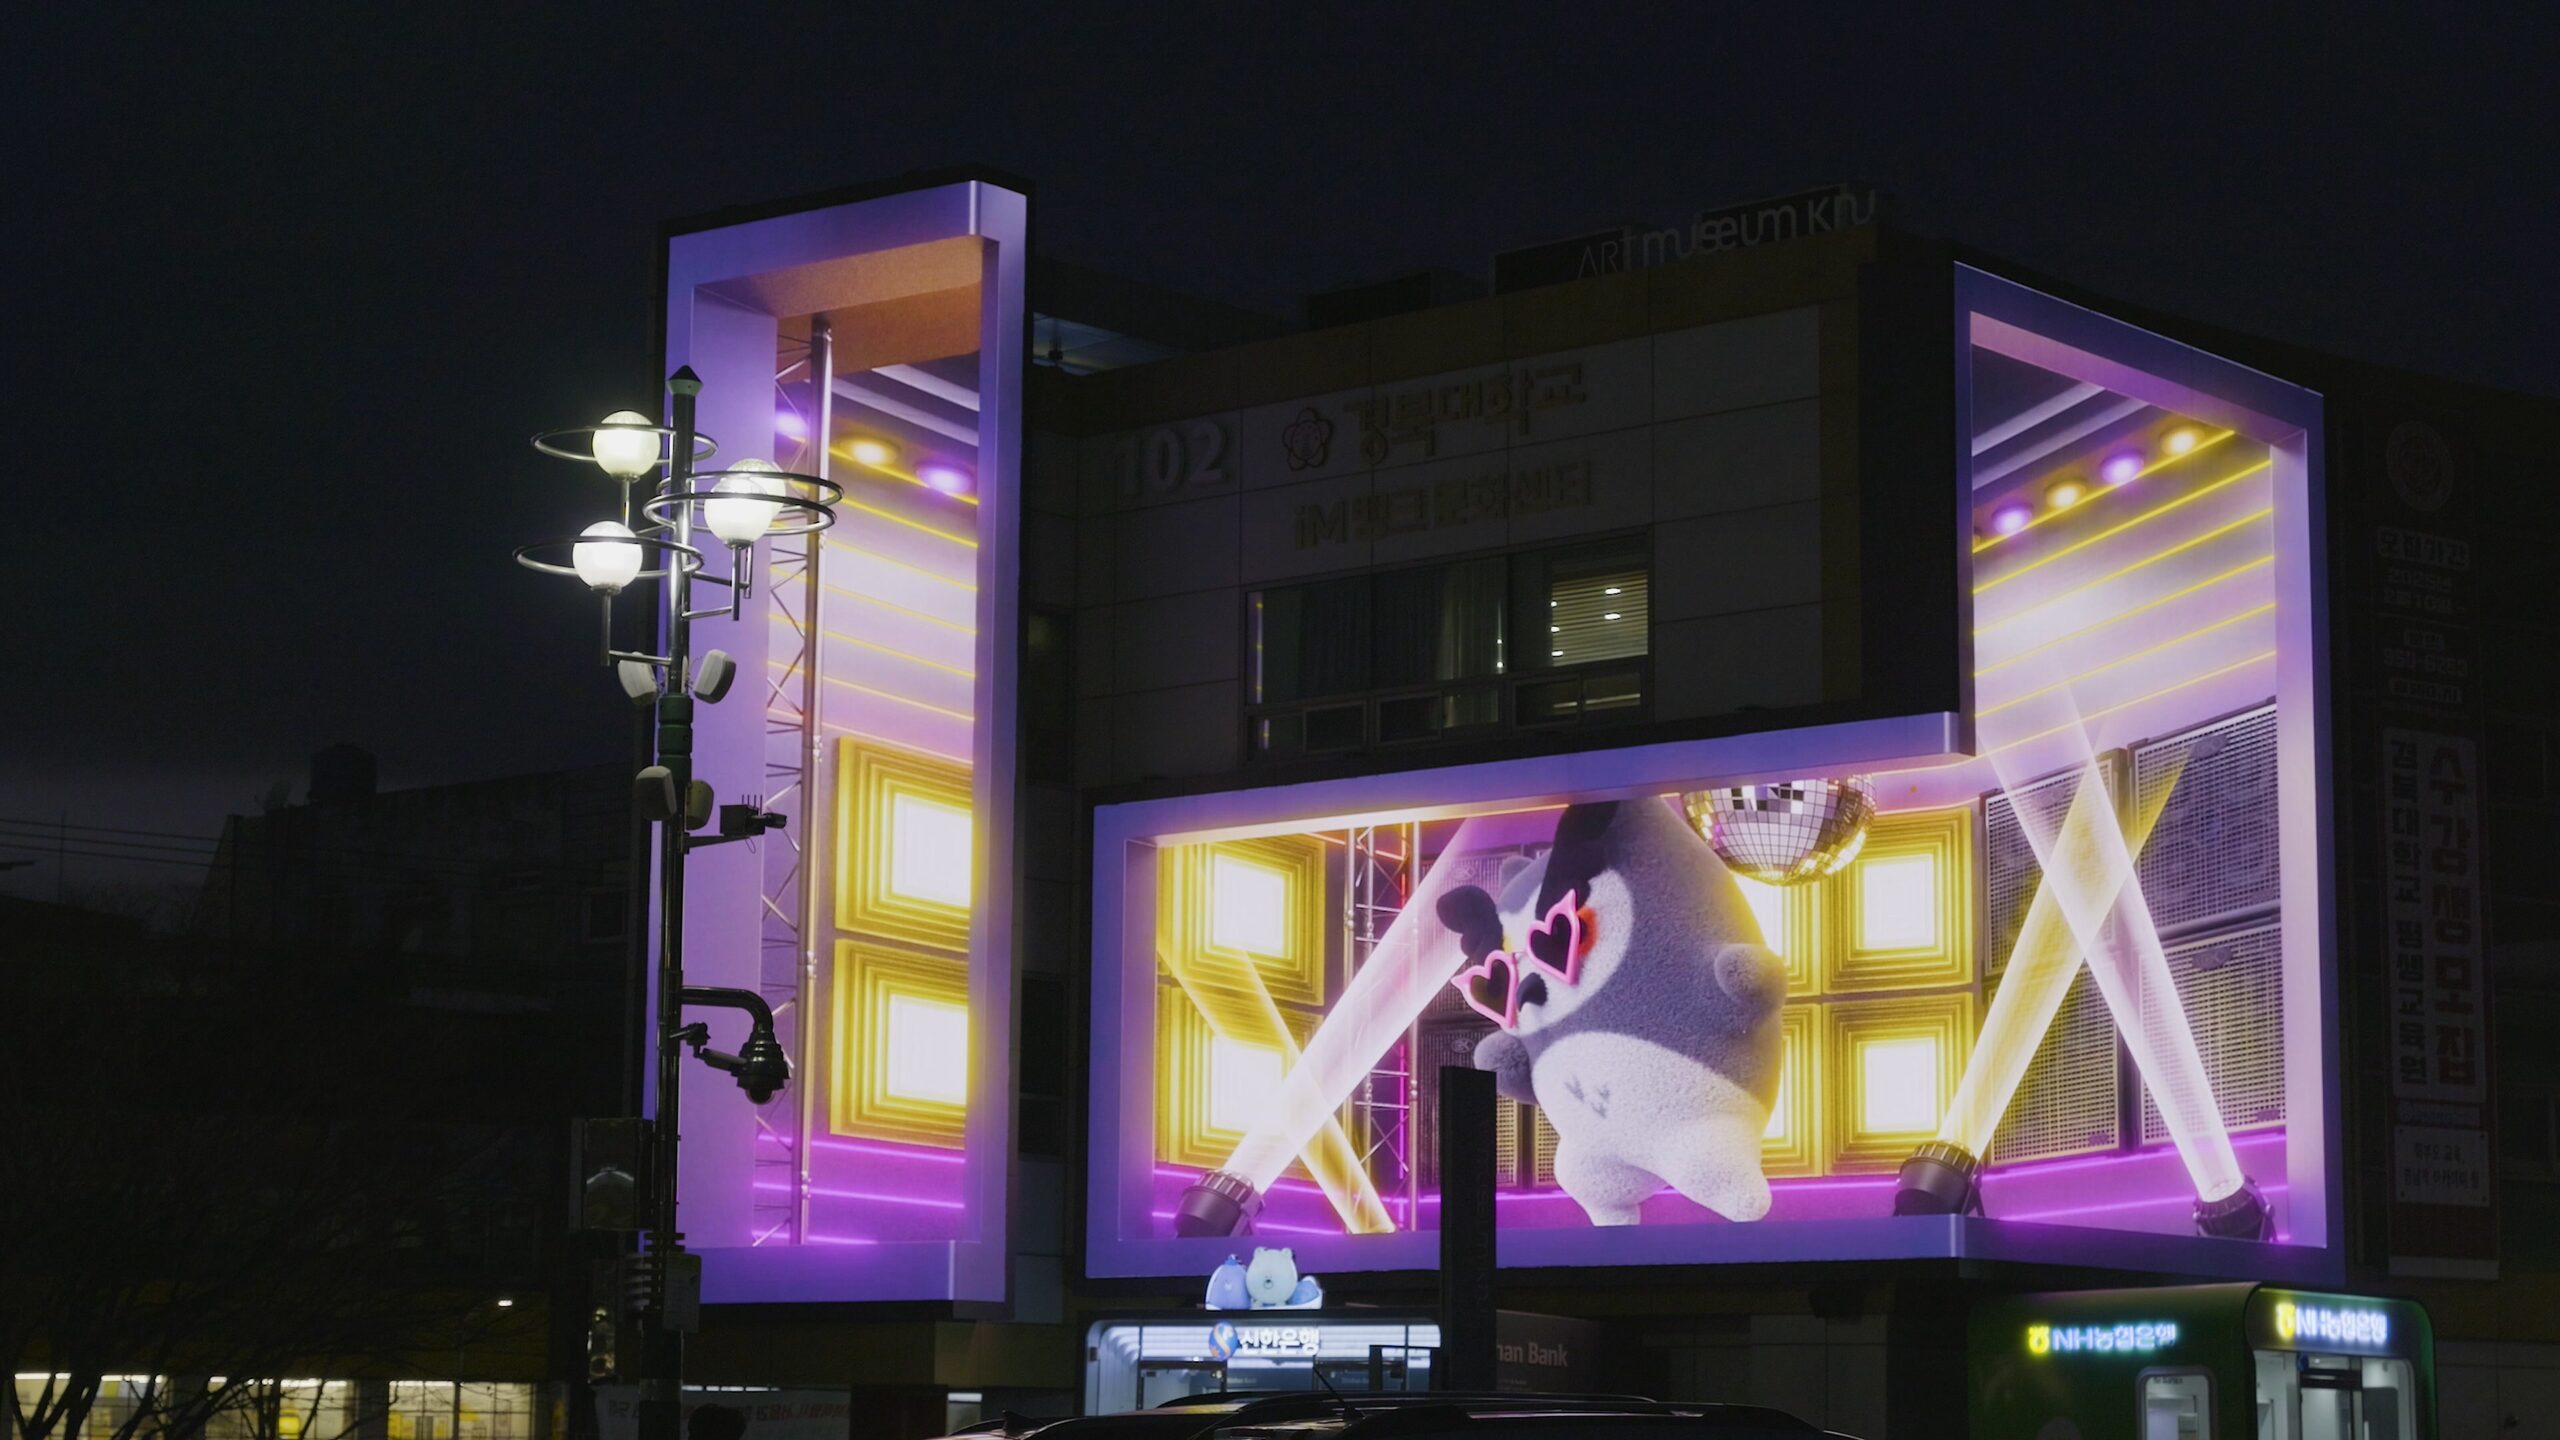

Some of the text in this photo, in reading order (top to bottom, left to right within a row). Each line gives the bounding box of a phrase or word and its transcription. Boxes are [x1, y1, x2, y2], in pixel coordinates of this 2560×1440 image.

[1345, 363, 1586, 465] 경북대학교
[1117, 420, 1230, 498] 102
[2391, 740, 2427, 1084] 경북대학교 평생교육원
[2430, 747, 2476, 1085] 수강생모집
[1239, 1328, 1319, 1356] 신한은행
[1528, 1342, 1568, 1367] Bank
[2051, 1323, 2176, 1351] NH농협은행
